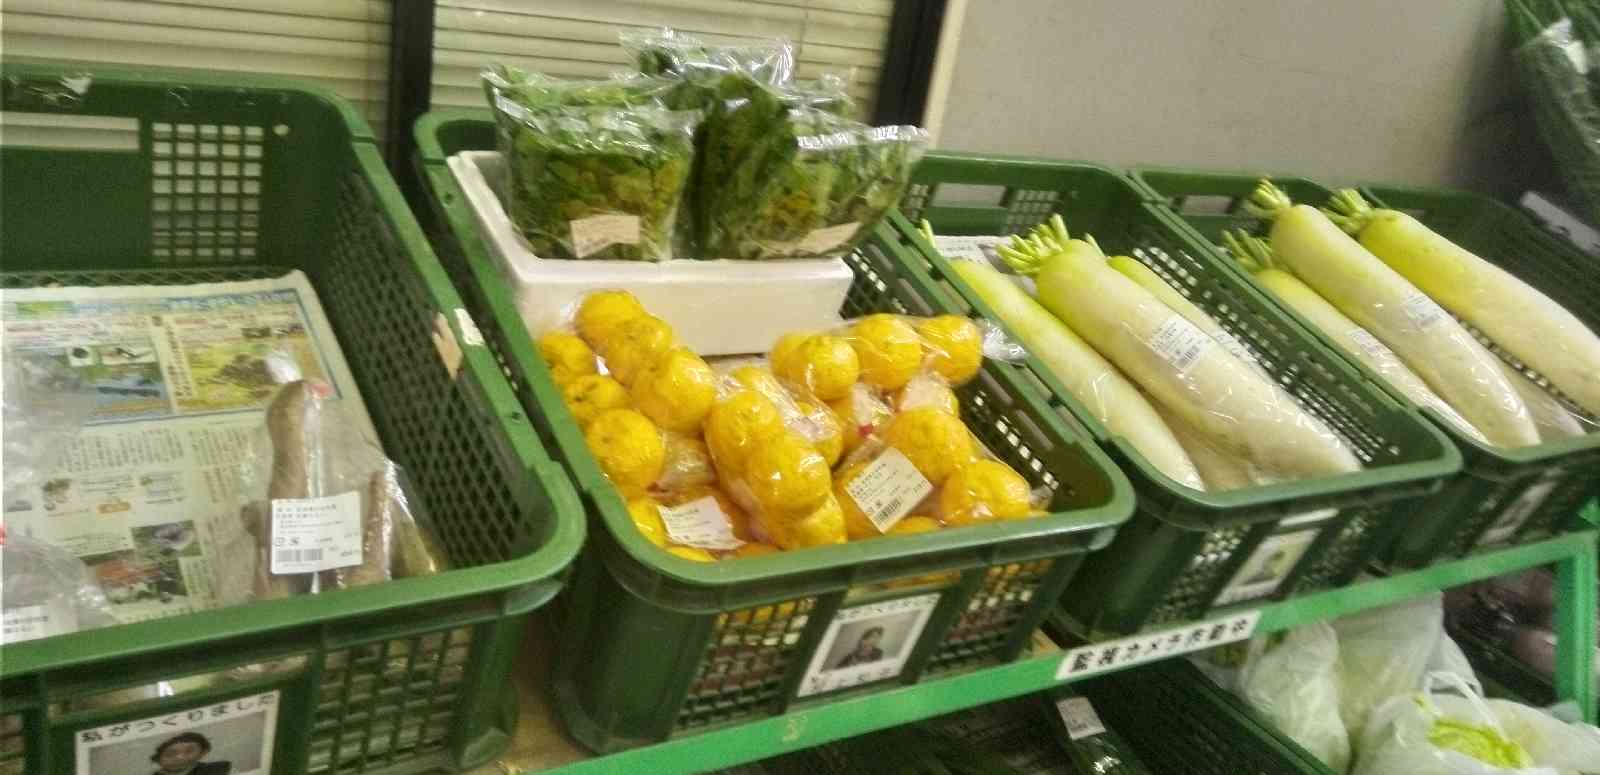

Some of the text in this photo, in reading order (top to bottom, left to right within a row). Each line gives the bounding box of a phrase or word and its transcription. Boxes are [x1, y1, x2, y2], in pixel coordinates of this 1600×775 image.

[81, 693, 276, 743] 私がつくりました
